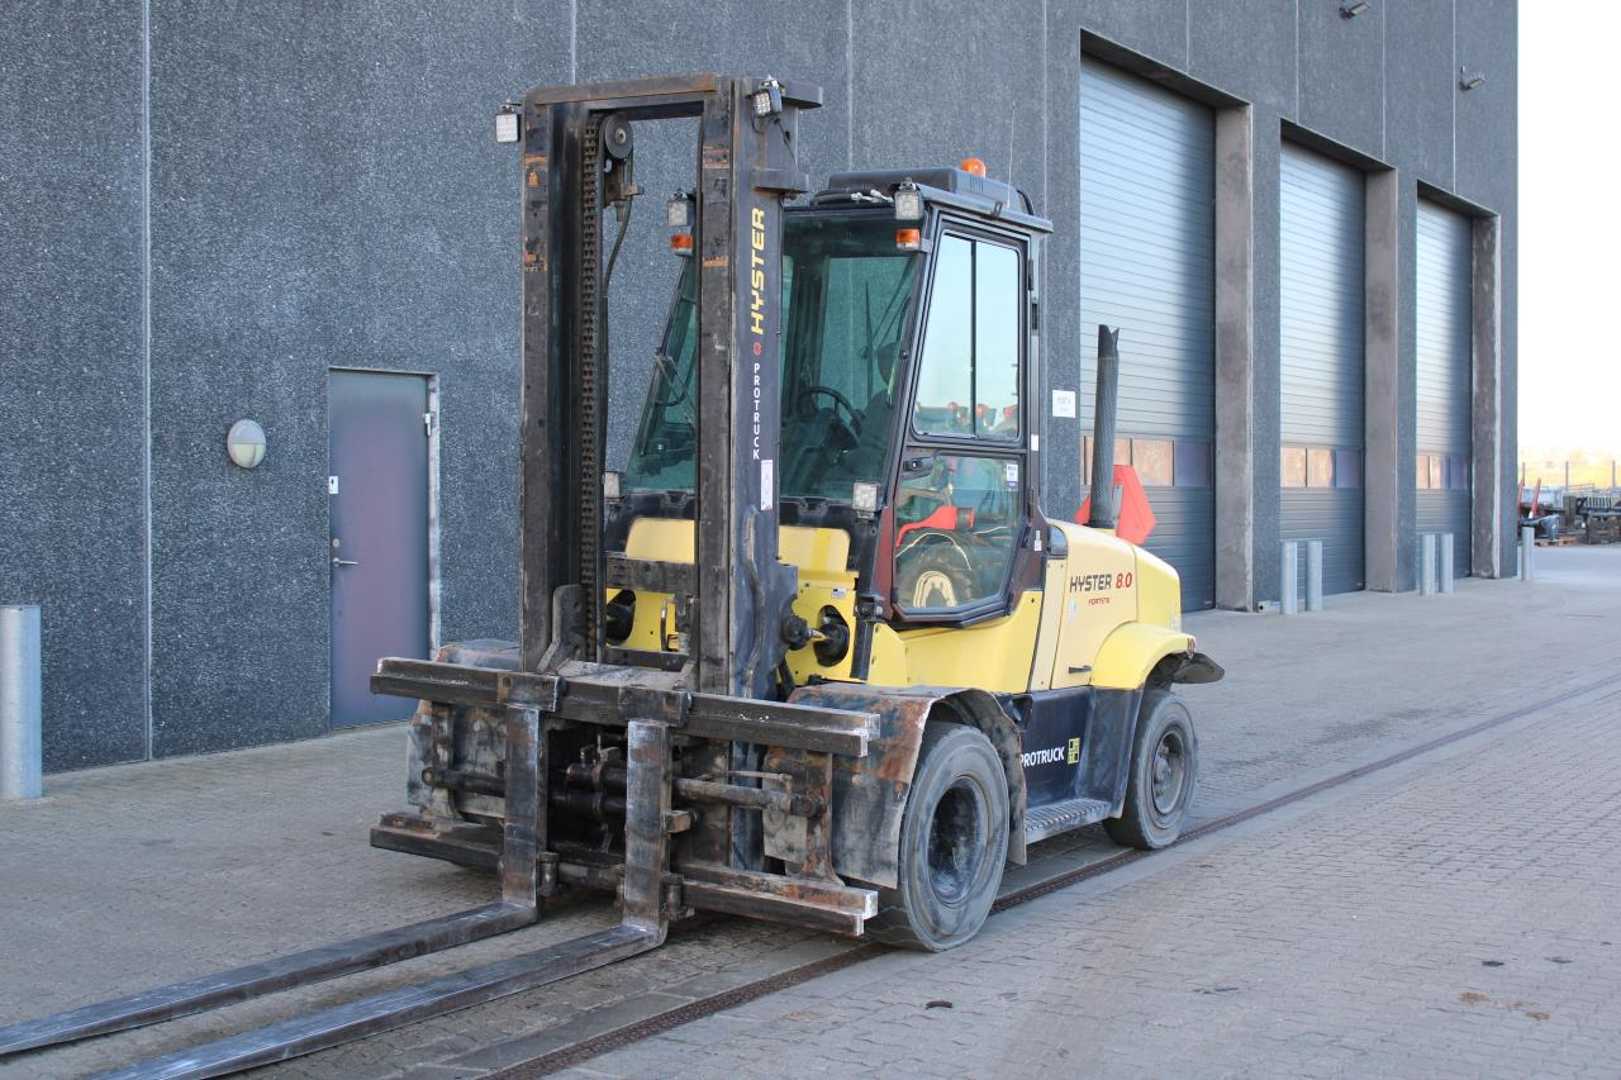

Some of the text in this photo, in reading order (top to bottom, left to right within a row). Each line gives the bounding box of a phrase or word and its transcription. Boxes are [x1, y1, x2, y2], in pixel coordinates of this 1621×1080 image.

[751, 207, 765, 335] HYSTER
[753, 362, 761, 461] PROTRUCK
[1069, 573, 1112, 593] HYSTER
